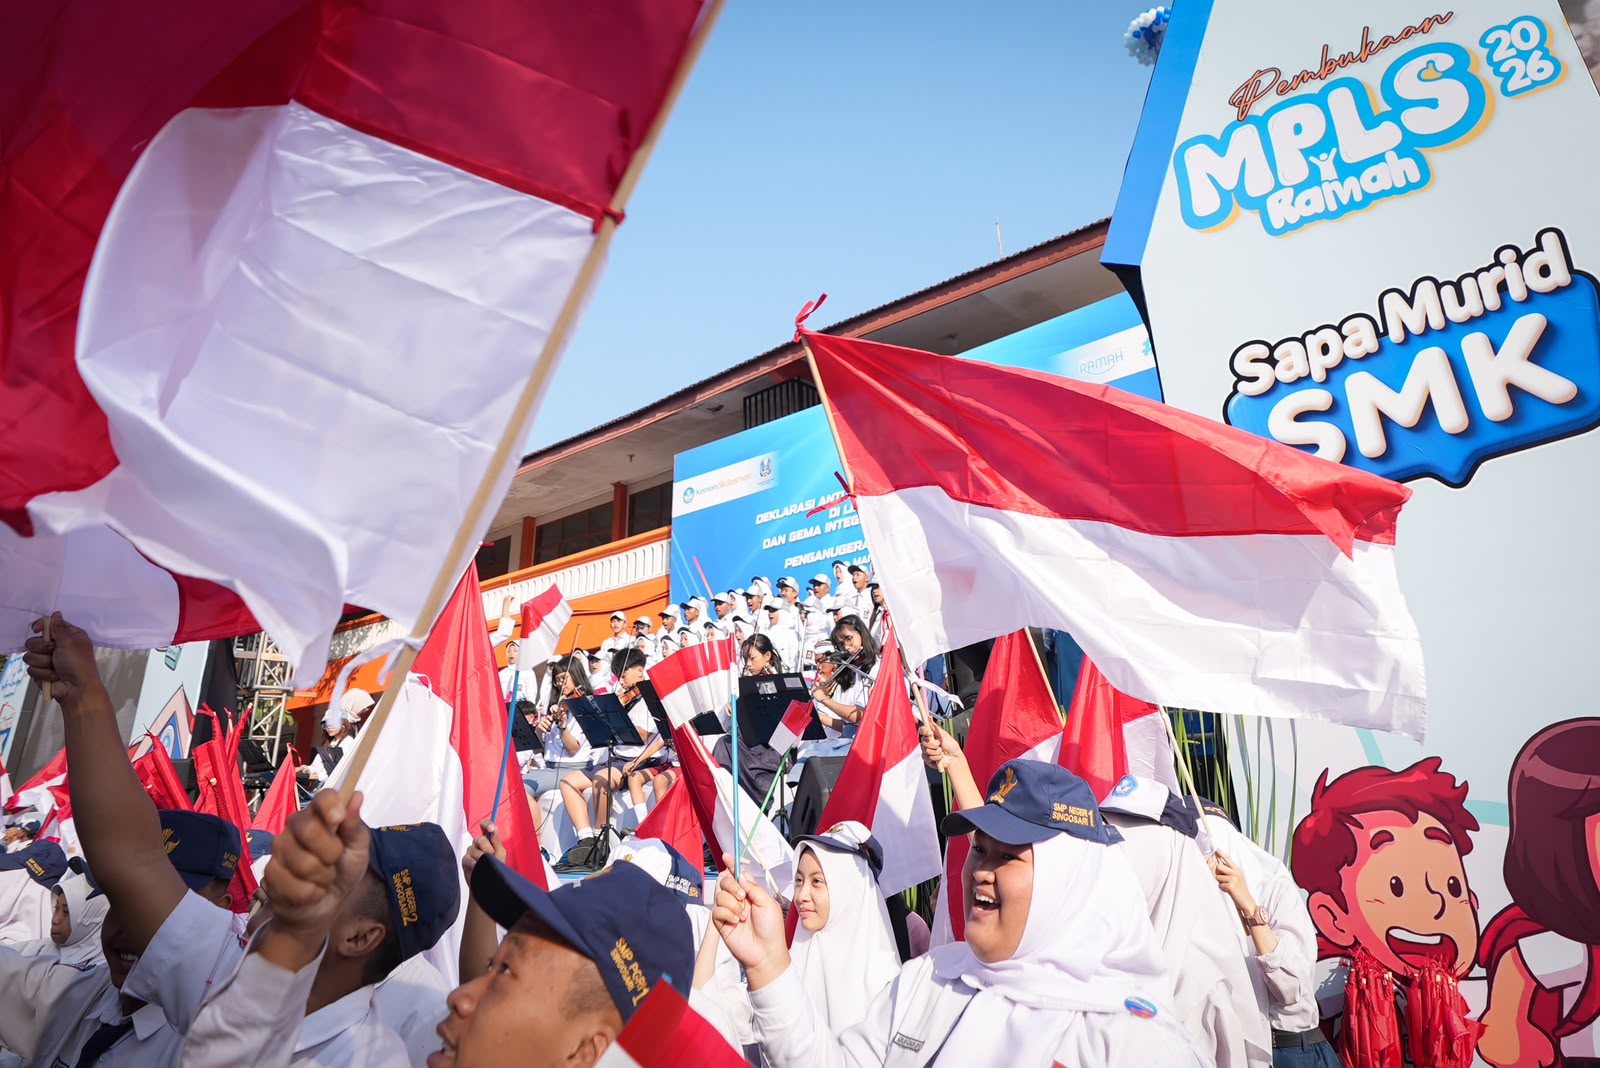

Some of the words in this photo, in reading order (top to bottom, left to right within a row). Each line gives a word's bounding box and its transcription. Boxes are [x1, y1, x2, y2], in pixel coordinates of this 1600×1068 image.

[1485, 20, 1540, 62] 20
[1229, 11, 1453, 121] Pembukaan
[1501, 51, 1556, 92] 26
[1184, 52, 1470, 217] MPLS
[1266, 151, 1420, 230] Ramah
[1233, 316, 1380, 396] Sapa
[1382, 228, 1572, 344] Murid
[1080, 351, 1124, 374] RAMAH
[1267, 312, 1578, 464] SMK
[756, 498, 816, 525] DEKLARASI
[829, 507, 841, 519] DI
[762, 534, 787, 550] DAN
[789, 525, 822, 543] GEMA
[1052, 811, 1088, 825] SINGOSARI
[1053, 803, 1067, 812] SMP
[1088, 809, 1095, 827] 1
[401, 869, 411, 885] SMP
[403, 913, 418, 926] 2
[615, 936, 634, 961] SMP
[628, 961, 648, 992] PGRI
[631, 987, 651, 1008] 1
